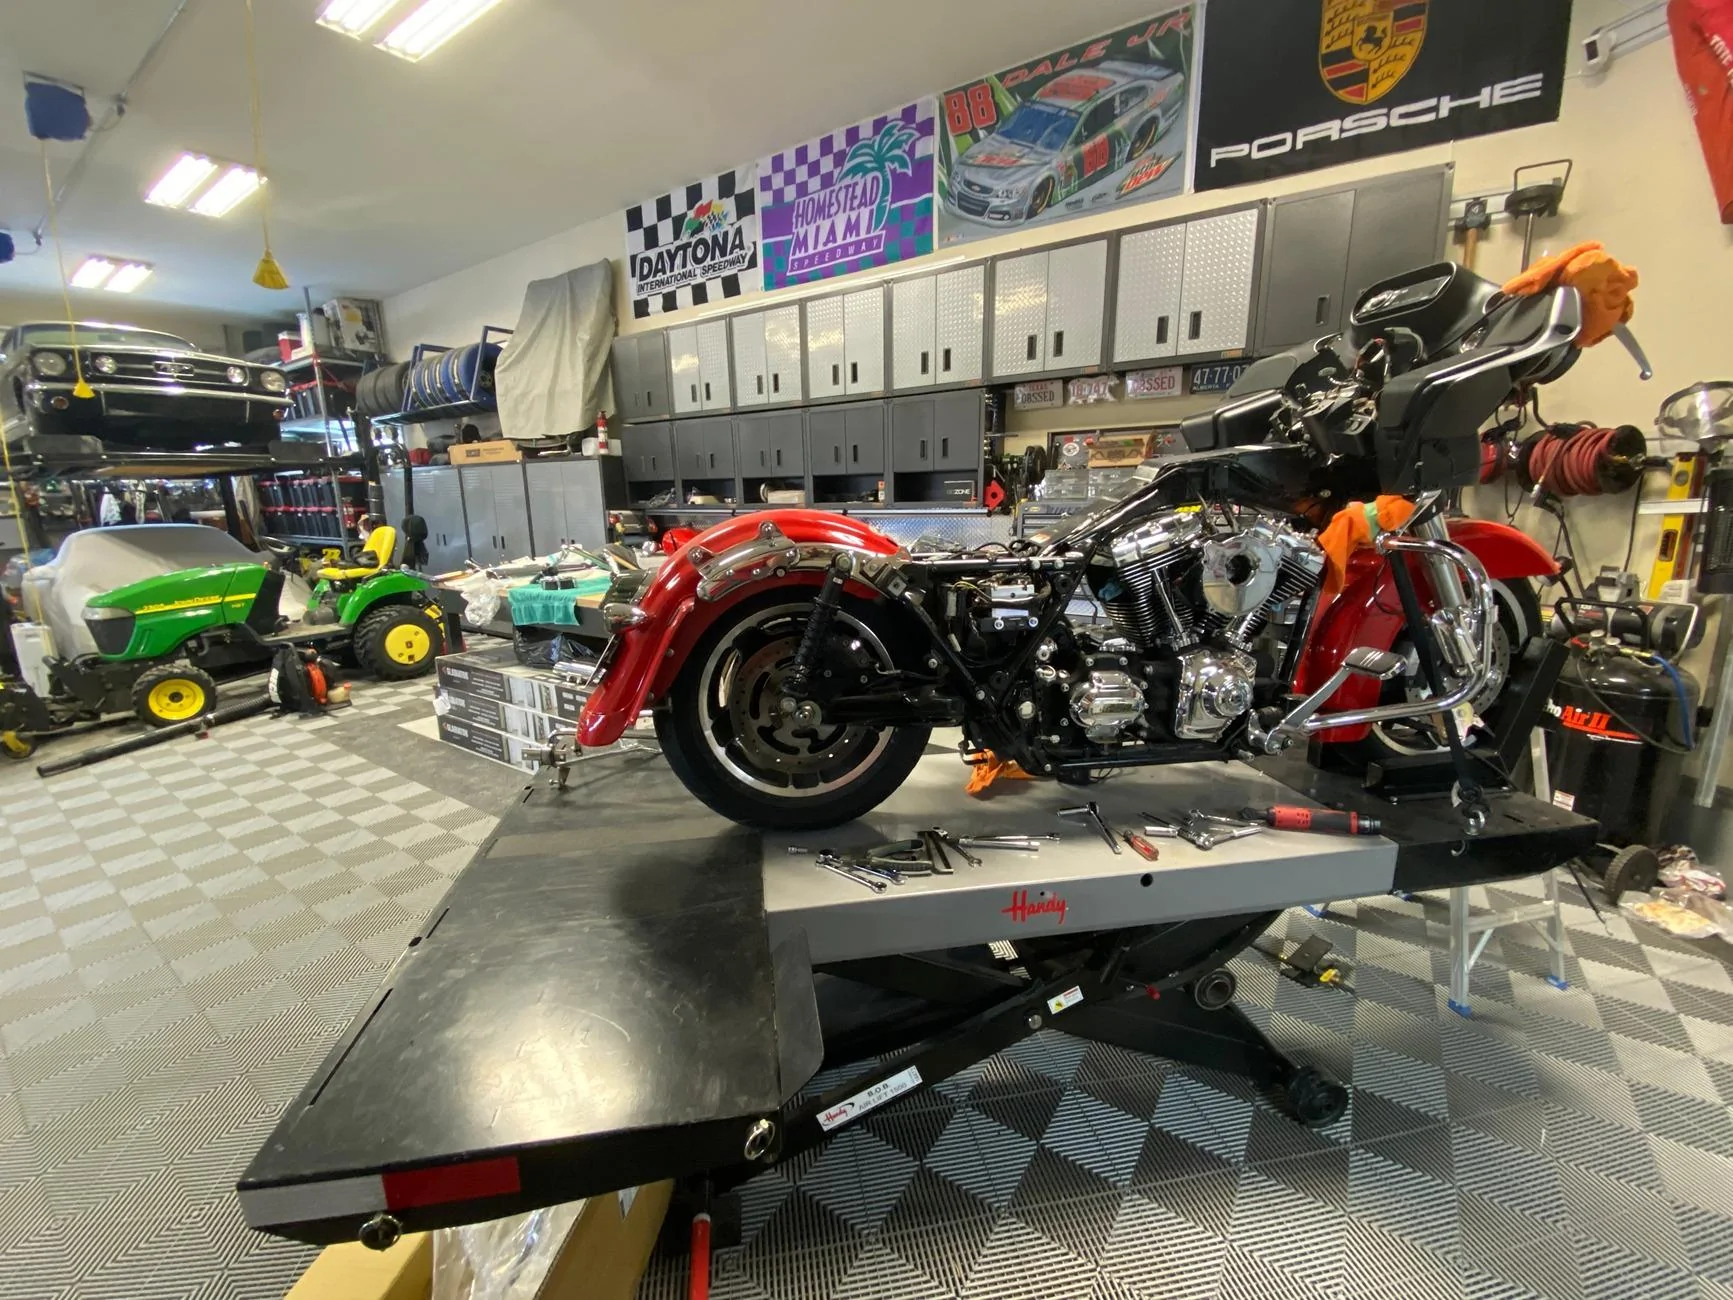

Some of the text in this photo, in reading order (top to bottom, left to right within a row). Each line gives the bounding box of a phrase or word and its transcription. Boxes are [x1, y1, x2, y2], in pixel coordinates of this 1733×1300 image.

[1002, 12, 1190, 88] DALE JR
[945, 84, 997, 135] 88
[1210, 73, 1543, 168] PORSCHE
[795, 175, 879, 228] HOMESTEAD
[640, 229, 745, 278] DAYTONA
[792, 210, 876, 257] MIAMI
[792, 240, 880, 269] SPEEDWAY
[637, 252, 748, 293] INTERNATIONAL SPEEDWAY
[1561, 705, 1590, 725] Air
[1002, 890, 1067, 924] Handy
[824, 1107, 848, 1122] Handy
